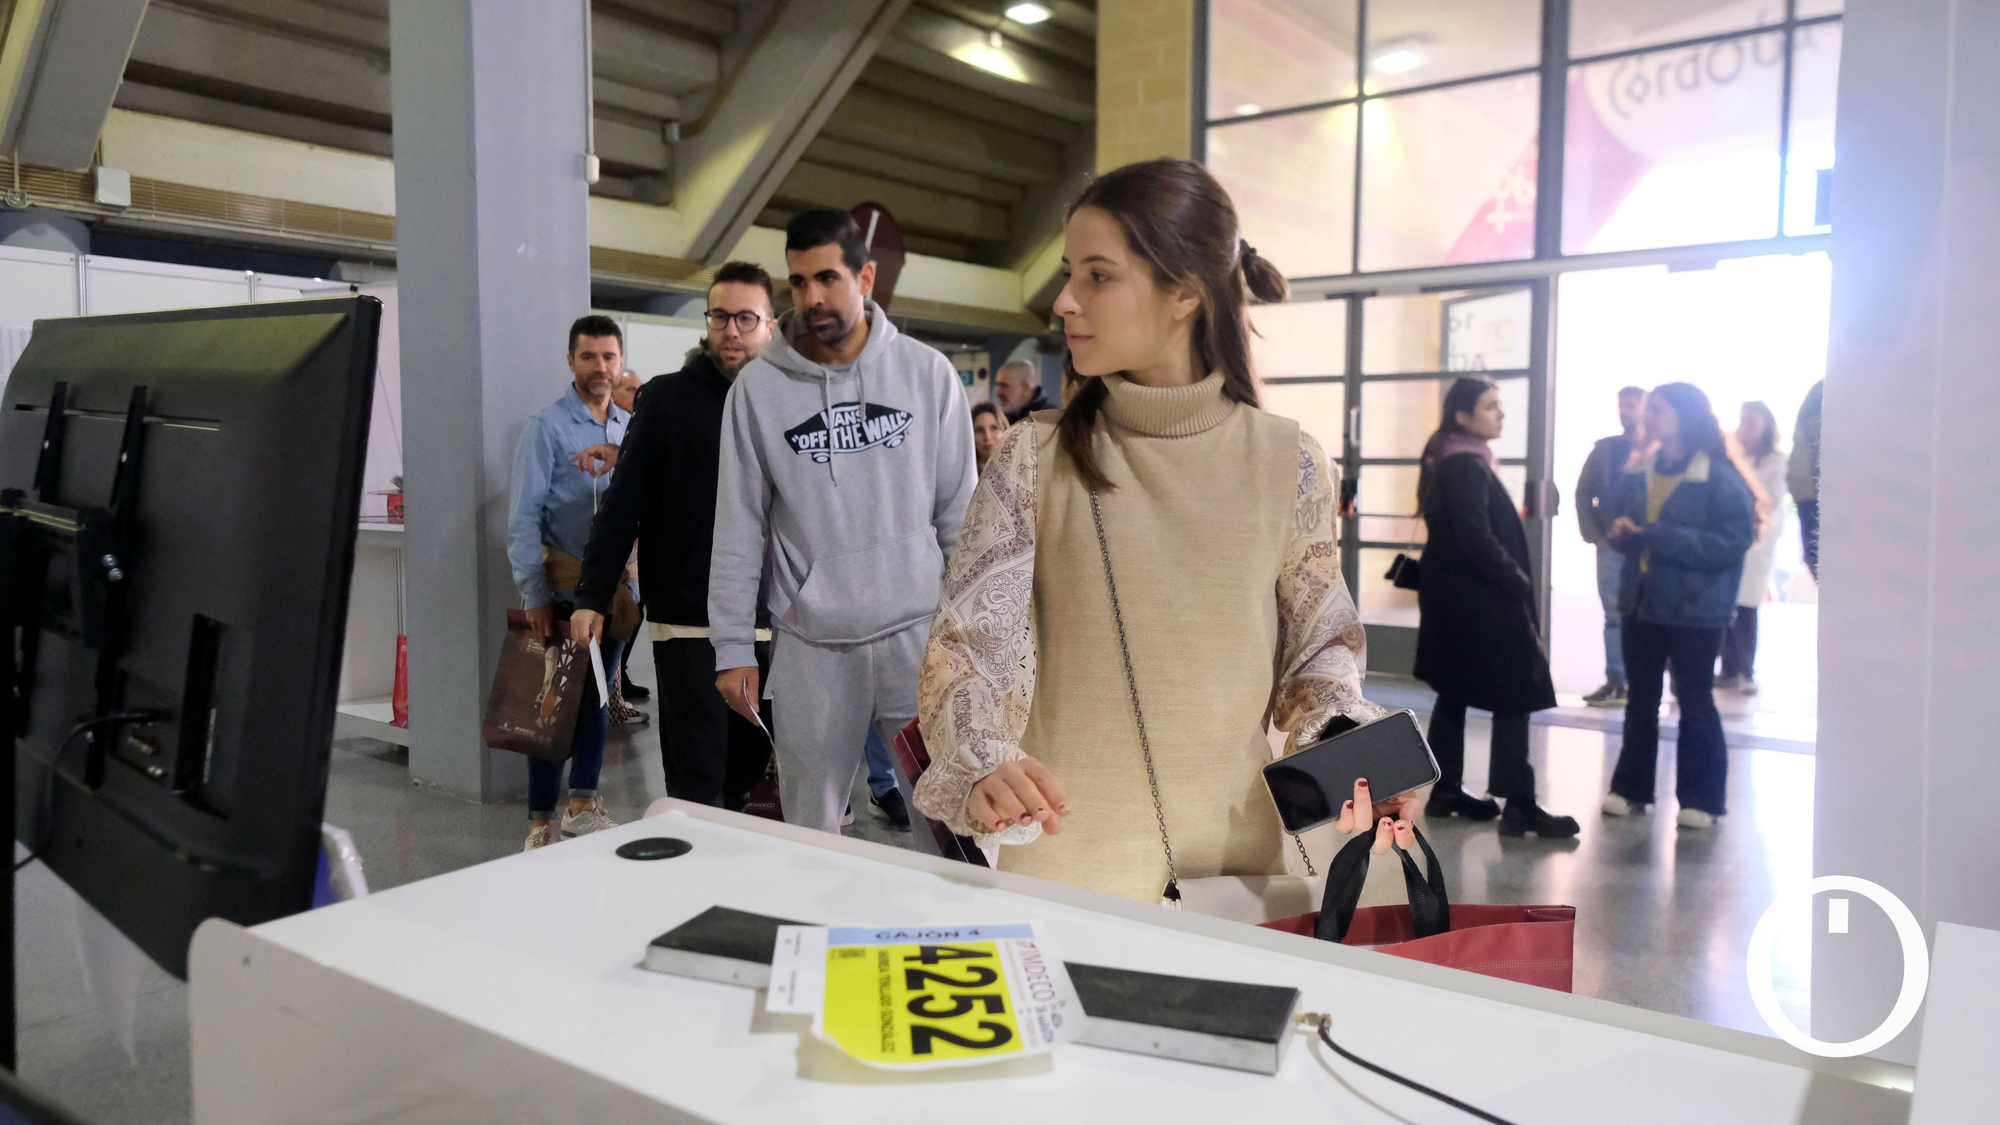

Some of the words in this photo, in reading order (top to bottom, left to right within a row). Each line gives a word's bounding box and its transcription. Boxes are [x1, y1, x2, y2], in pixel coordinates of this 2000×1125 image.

[819, 409, 867, 429] VANS
[829, 424, 866, 450] THE
[968, 929, 980, 937] 4
[1019, 949, 1056, 1001] IMDECO
[904, 944, 1013, 1056] 4252
